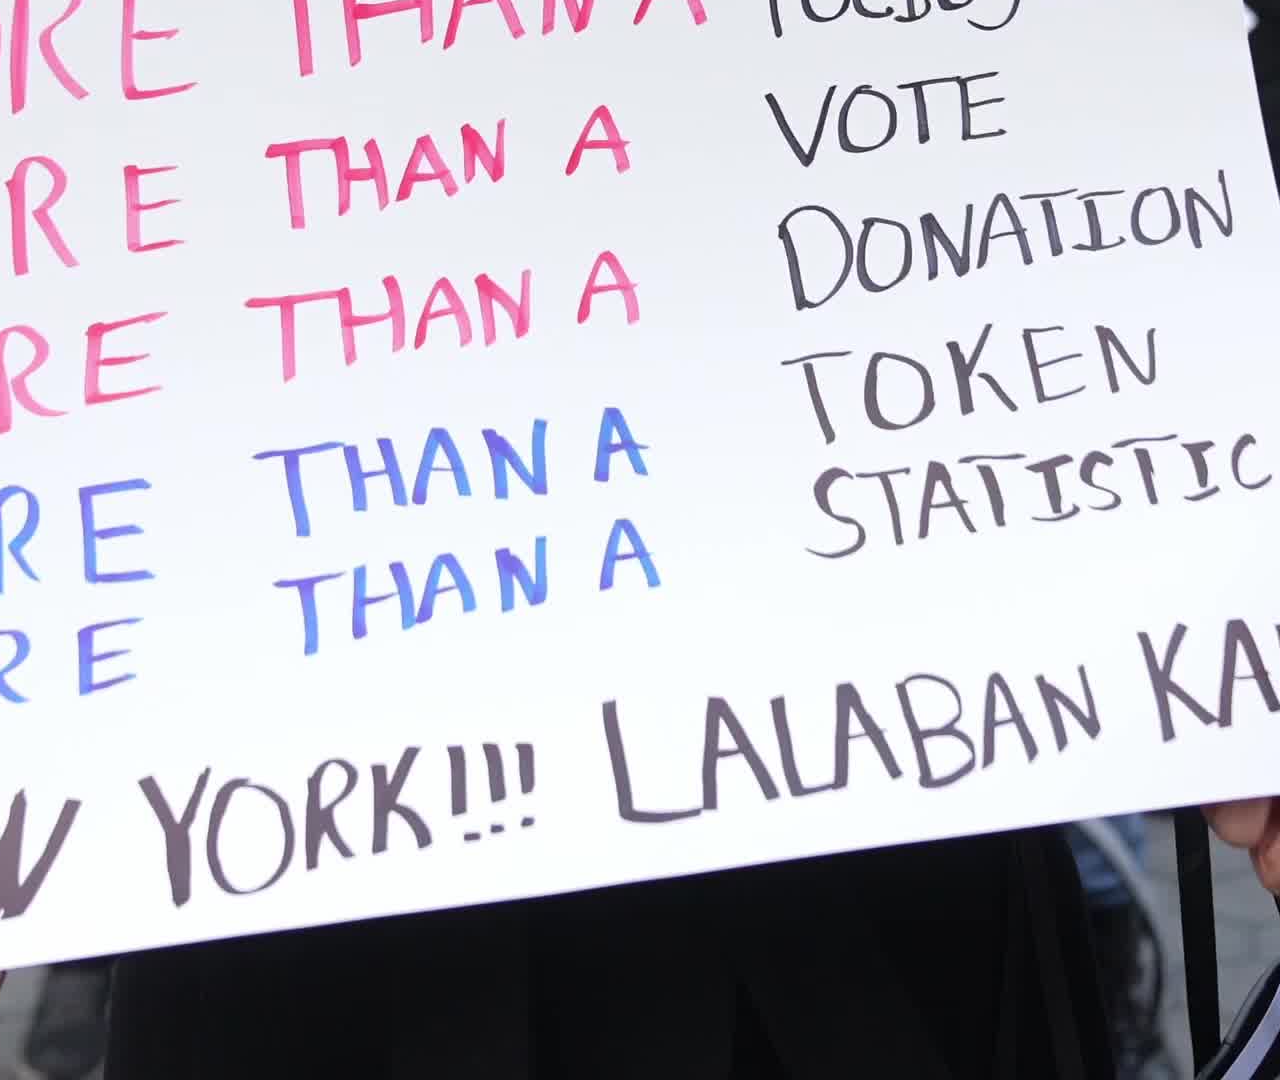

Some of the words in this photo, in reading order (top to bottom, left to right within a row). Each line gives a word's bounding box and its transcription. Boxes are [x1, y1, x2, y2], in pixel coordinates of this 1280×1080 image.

[265, 119, 505, 229] THAN
[565, 105, 630, 176] A
[765, 72, 1007, 167] VOTE
[245, 270, 530, 382] THAN
[577, 251, 639, 324] A
[778, 169, 1232, 311] DONATION
[253, 419, 547, 536] THAN
[594, 408, 648, 482] A
[781, 323, 1158, 444] TOKEN
[274, 536, 547, 656] THAN
[600, 519, 660, 590] A
[808, 434, 1272, 558] STATISTIC
[138, 743, 534, 907] YORK!!!
[603, 665, 1101, 823] LALABAN
